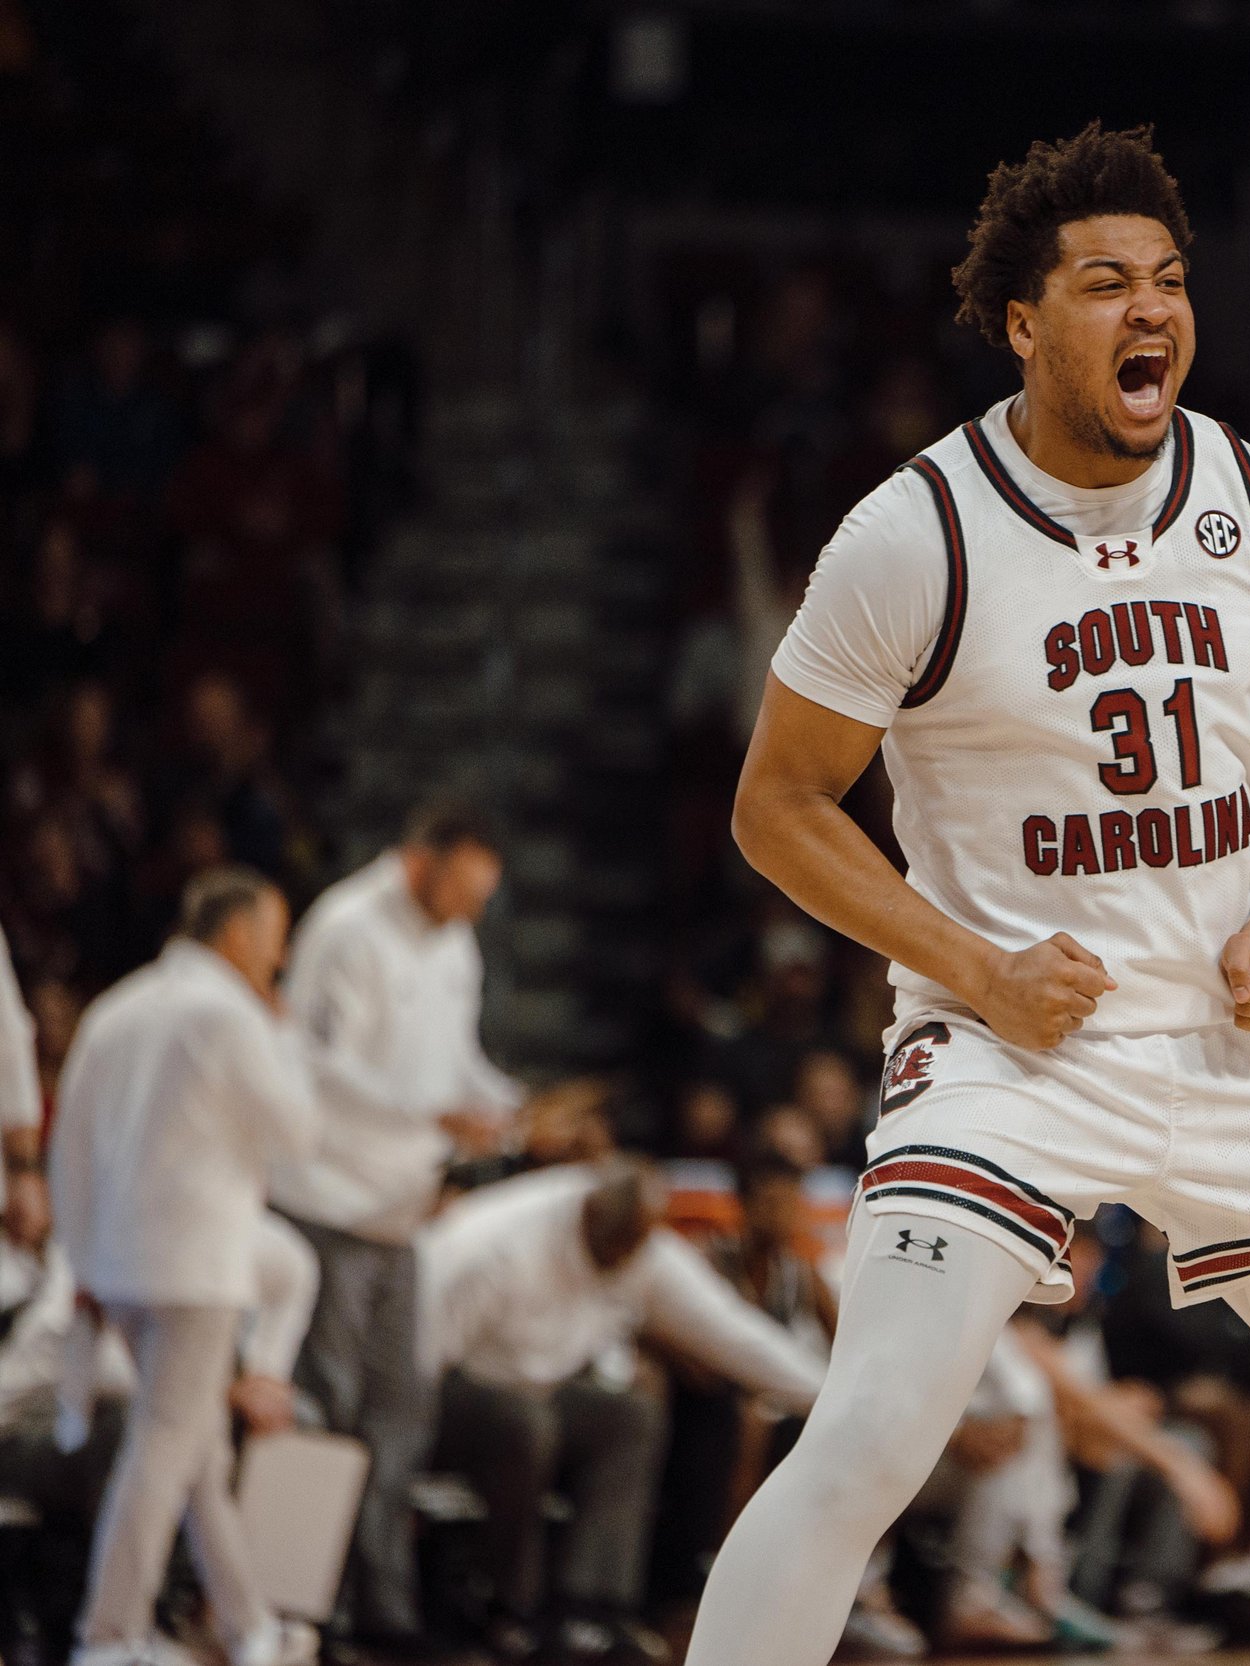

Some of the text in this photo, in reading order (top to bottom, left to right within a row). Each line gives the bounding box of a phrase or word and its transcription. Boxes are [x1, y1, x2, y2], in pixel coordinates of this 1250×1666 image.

[1197, 512, 1239, 556] SEC
[1044, 600, 1229, 692] SOUTH
[1089, 677, 1202, 795] 31
[888, 1254, 946, 1274] UNDER ARMOUR
